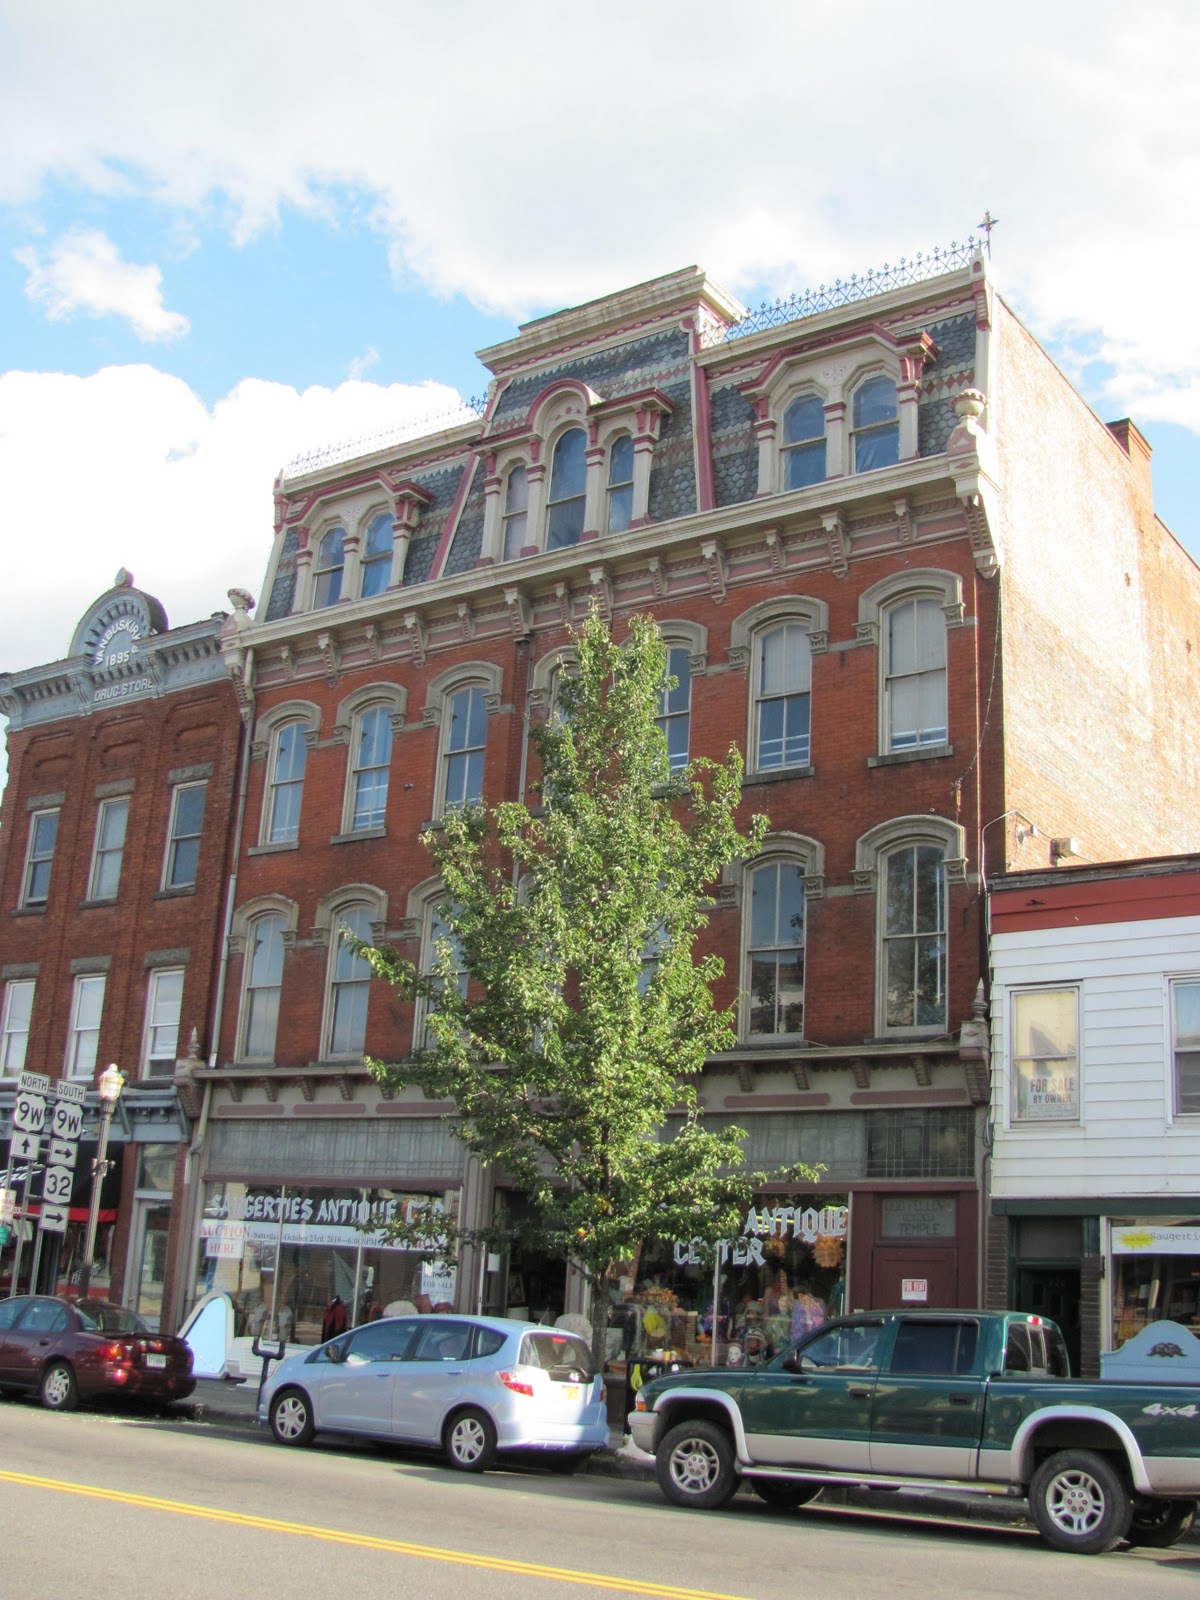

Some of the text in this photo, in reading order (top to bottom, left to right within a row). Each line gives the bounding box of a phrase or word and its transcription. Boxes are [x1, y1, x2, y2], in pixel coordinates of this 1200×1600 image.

[106, 650, 130, 666] 1895
[21, 1075, 48, 1091] NORTH
[58, 1083, 84, 1099] SOUTH
[1030, 1077, 1075, 1093] FOR SALE
[1033, 1093, 1072, 1104] BY OWNER
[19, 1100, 43, 1126] 9W
[57, 1109, 80, 1133] 9W
[46, 1174, 71, 1197] 32
[210, 1193, 314, 1221] SAUGERTIES
[315, 1198, 398, 1225] ANTIQUE
[200, 1224, 250, 1238] AUCTION
[744, 1205, 849, 1243] ANTIQUE
[900, 1223, 940, 1235] TEMPLE
[210, 1242, 236, 1254] HERE
[673, 1235, 767, 1266] CETER
[1142, 1402, 1199, 1418] 4x4
